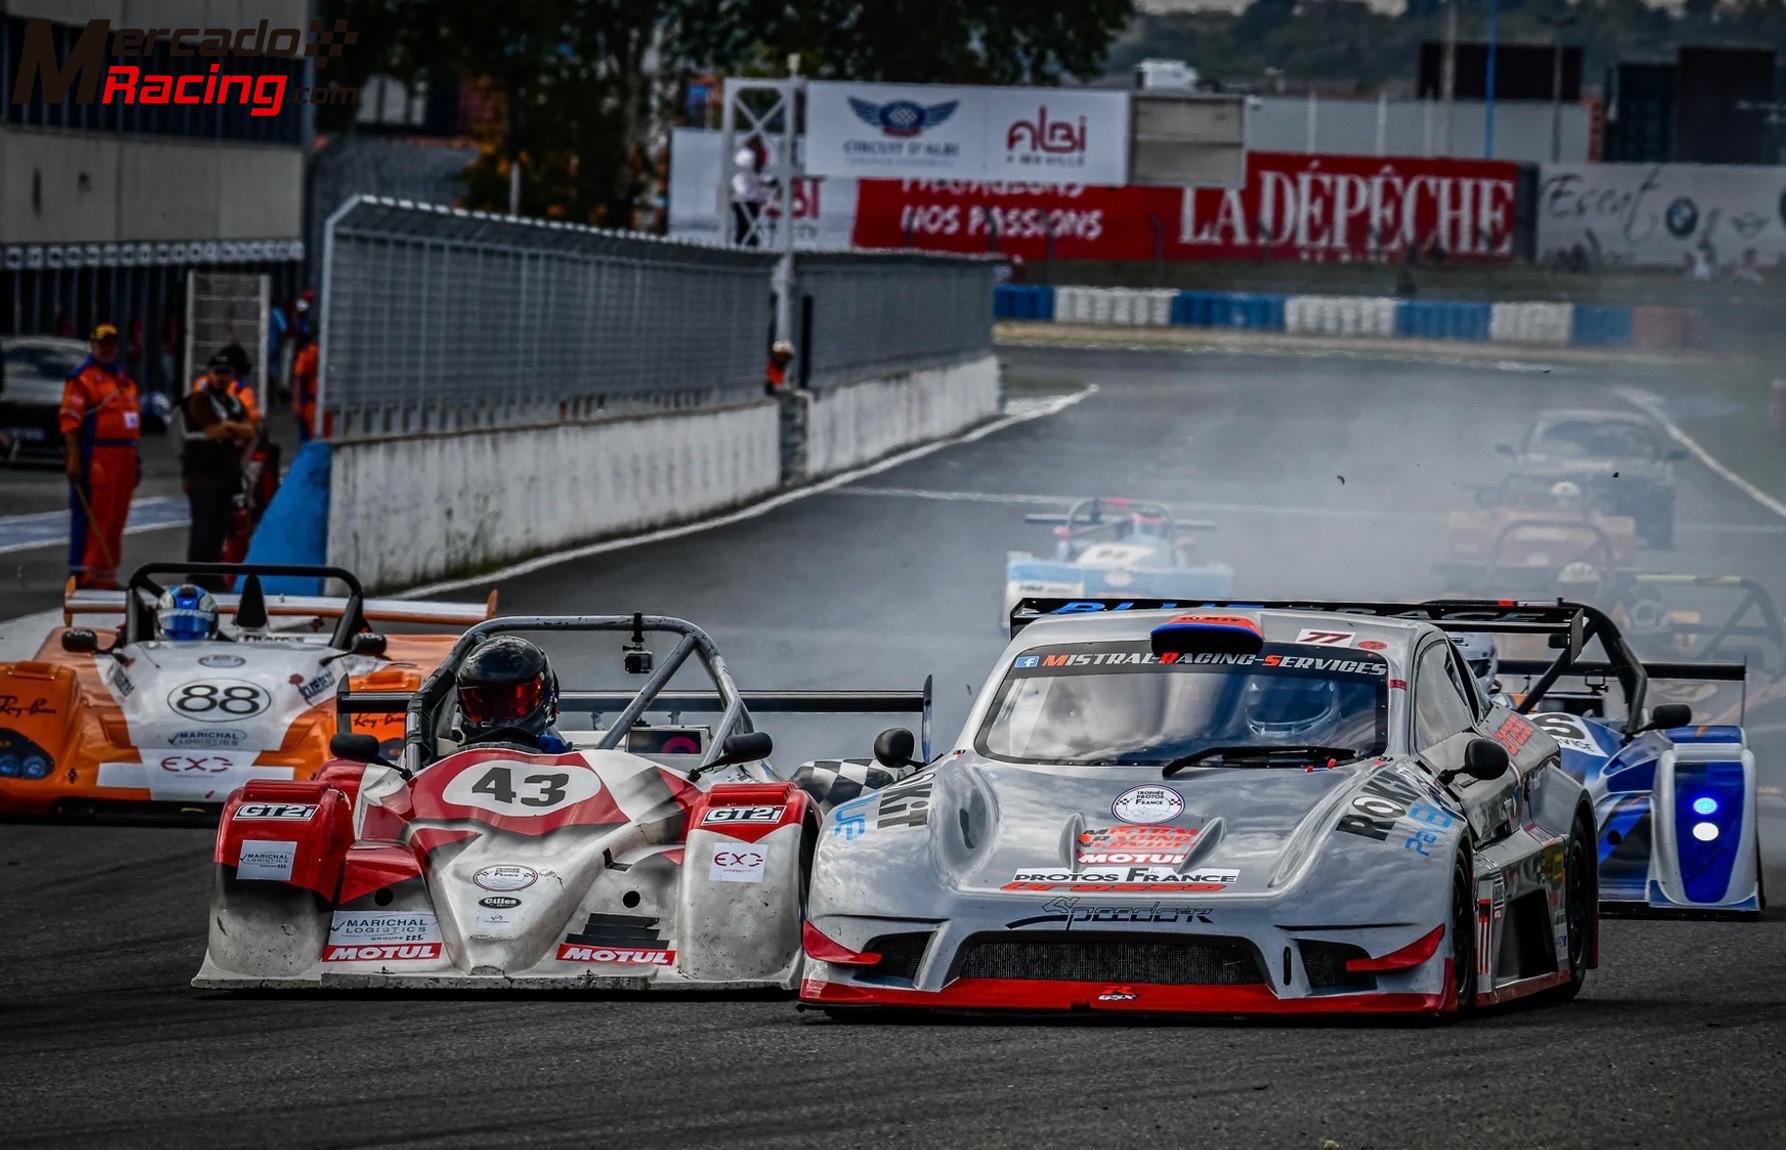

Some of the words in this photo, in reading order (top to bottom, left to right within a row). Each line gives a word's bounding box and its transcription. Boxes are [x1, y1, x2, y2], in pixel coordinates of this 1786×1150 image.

[1179, 189, 1249, 246] LA
[1258, 160, 1516, 257] DÉPÊCHE
[901, 204, 960, 235] NOS
[967, 205, 1104, 240] PASSIONS
[1302, 631, 1353, 644] 77
[176, 684, 260, 715] 88
[179, 732, 238, 740] MARICHAL
[472, 766, 570, 807] 43
[239, 803, 315, 817] GT2i
[706, 807, 782, 821] GT2i
[1078, 854, 1186, 864] MOTUL
[1014, 873, 1119, 882] PROTOS
[1126, 867, 1237, 883] FRANCE
[345, 926, 427, 934] LOGISTICS
[346, 919, 428, 928] MARICHAL
[328, 946, 436, 960] MOTUL
[562, 947, 670, 964] MOTUL
